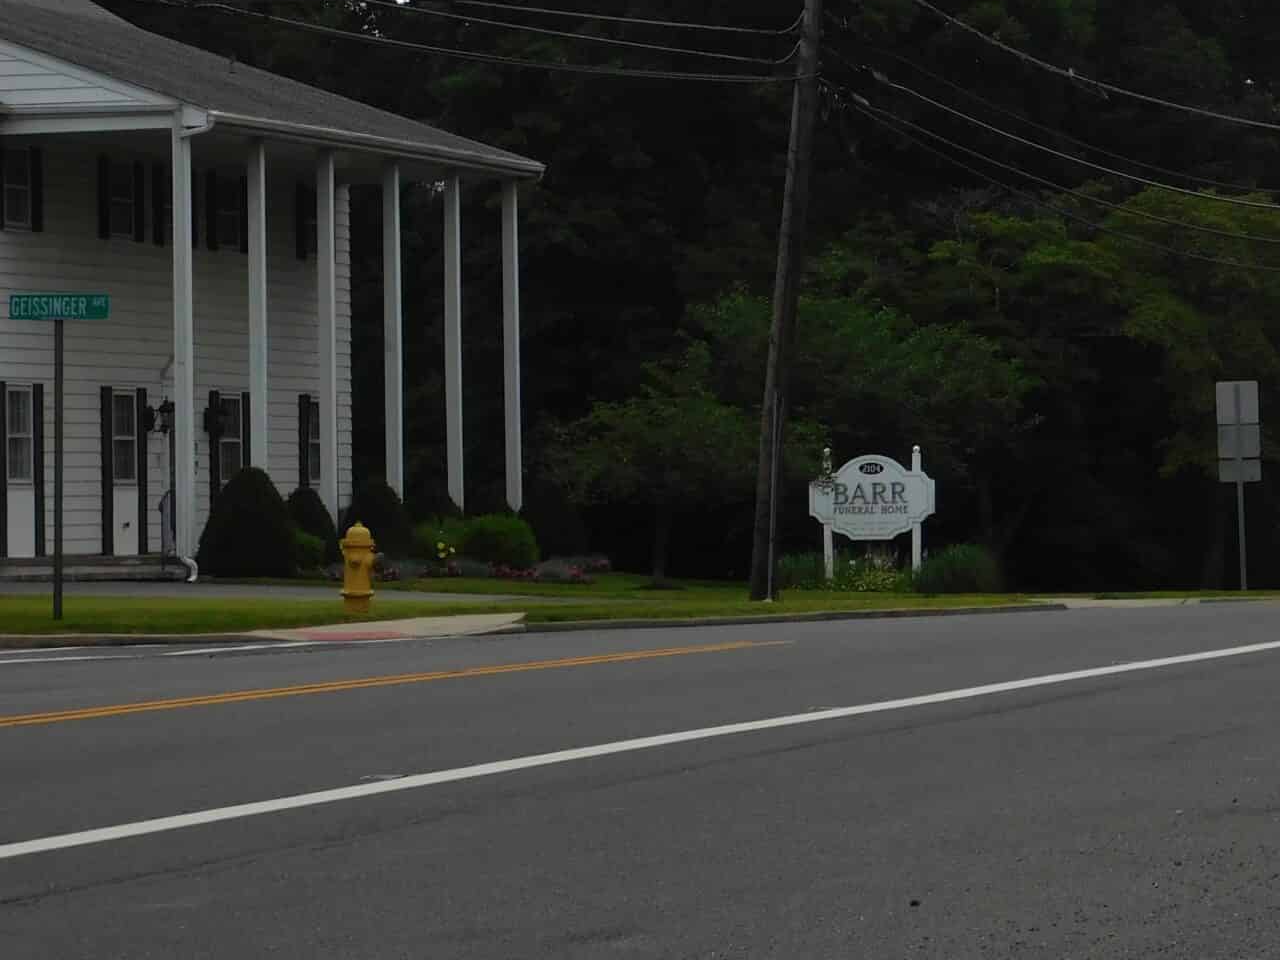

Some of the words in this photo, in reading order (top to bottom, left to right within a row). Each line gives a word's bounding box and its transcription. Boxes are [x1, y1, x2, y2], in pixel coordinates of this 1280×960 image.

[11, 296, 87, 316] GEISSINGER
[863, 463, 881, 473] 2104
[833, 482, 908, 505] BARR
[833, 506, 875, 515] FUNERAL
[881, 505, 908, 515] HOME
